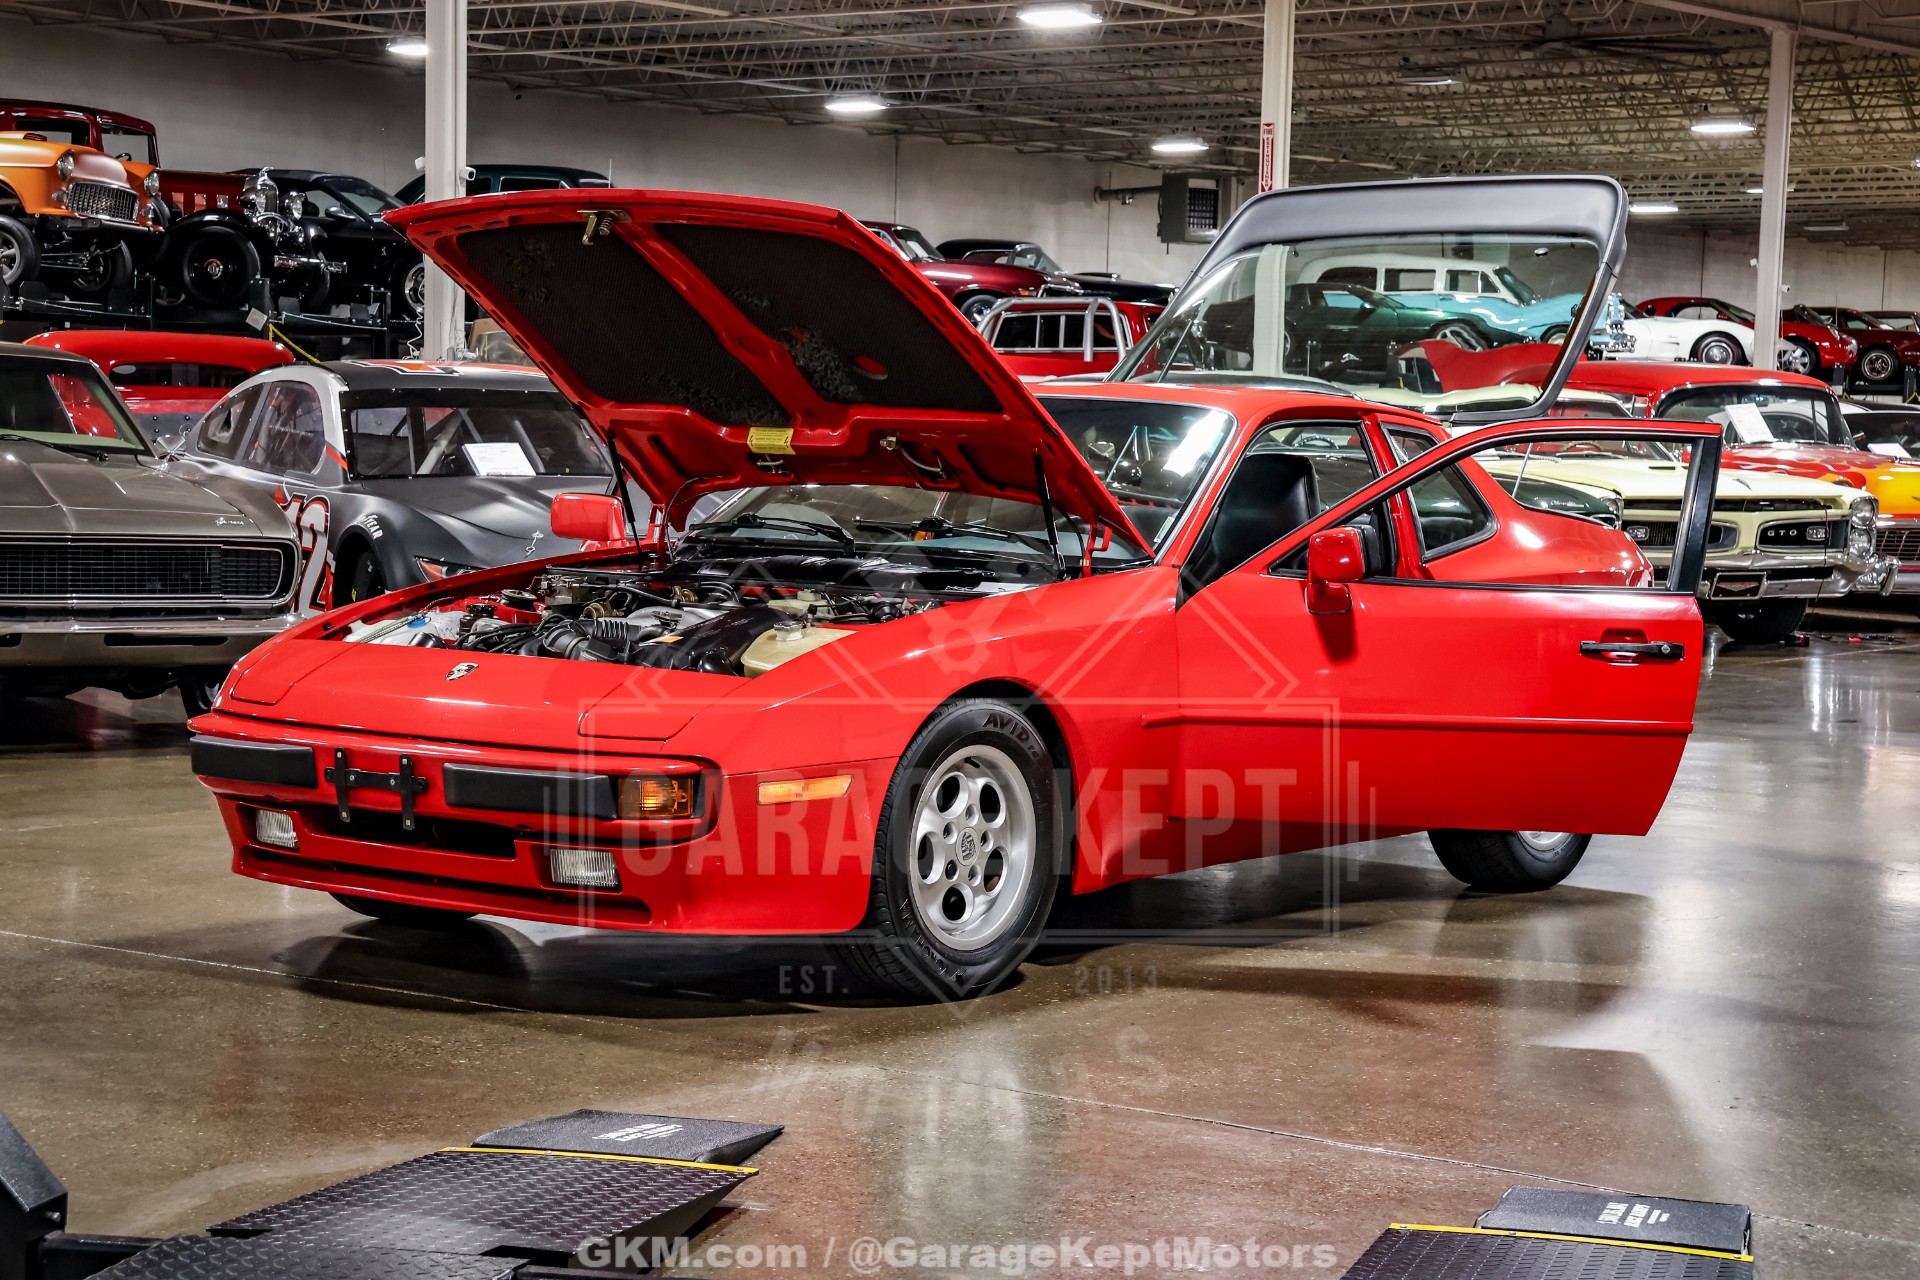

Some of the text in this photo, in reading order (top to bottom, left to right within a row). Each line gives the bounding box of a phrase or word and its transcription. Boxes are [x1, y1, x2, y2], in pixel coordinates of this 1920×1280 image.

[1767, 529, 1797, 537] GTO
[982, 713, 1030, 743] AVID
[899, 898, 949, 976] YOKOHAMA
